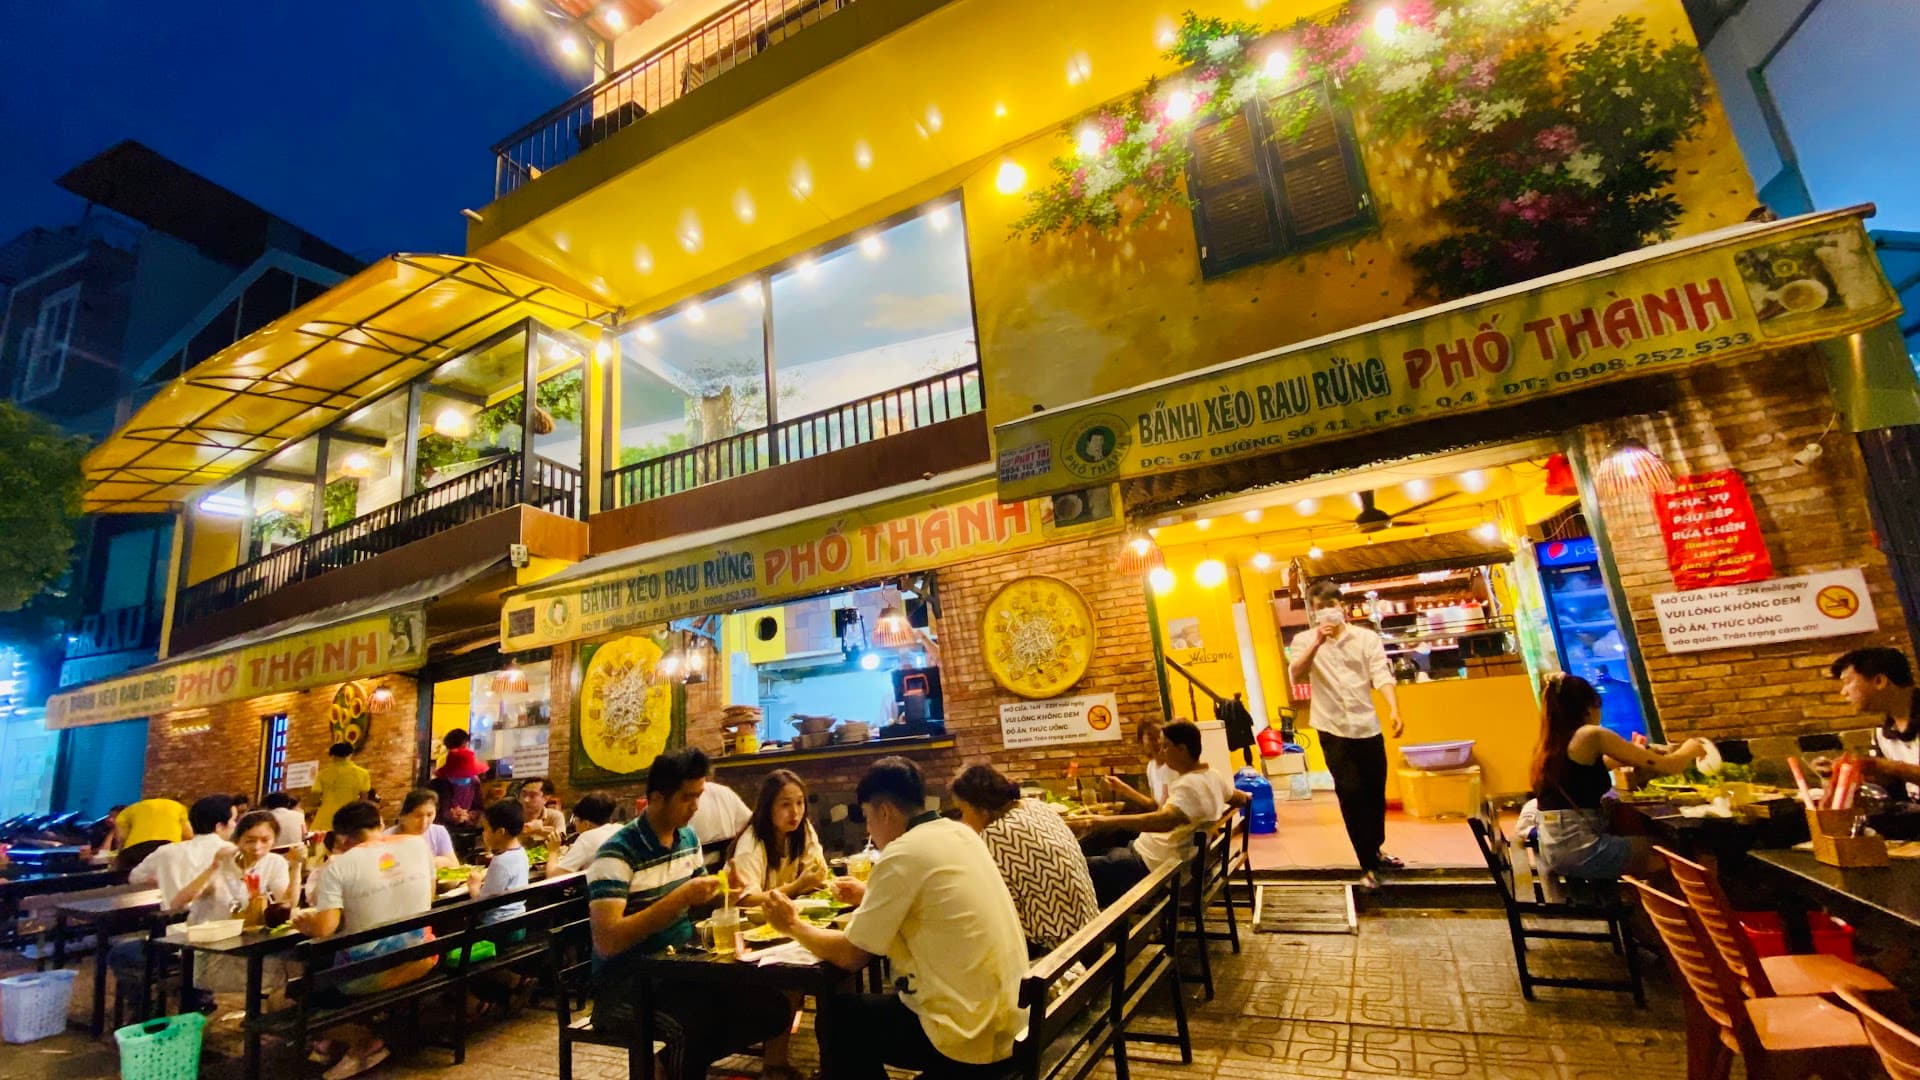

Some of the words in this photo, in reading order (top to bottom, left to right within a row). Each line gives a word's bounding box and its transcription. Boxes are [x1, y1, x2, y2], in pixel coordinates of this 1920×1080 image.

[1403, 314, 1512, 390] PHỐ
[1524, 278, 1734, 361] THÀNH
[1138, 401, 1201, 447] BÁNH
[1204, 385, 1254, 436] XÈO
[1257, 375, 1309, 423] RAU
[1312, 357, 1391, 409] RỪNG
[1179, 451, 1202, 463] 97
[1210, 433, 1283, 457] ĐƯỜNG
[1324, 419, 1350, 432] 41
[1375, 405, 1414, 422] P.6
[1555, 331, 1755, 384] 0908.252.533
[764, 519, 850, 587] PHỐ
[860, 498, 1030, 564] THÀNH
[580, 579, 623, 616] BÁNH
[625, 570, 661, 608] XÈO
[664, 564, 699, 598] RAU
[703, 549, 755, 589] RỪNG
[1665, 608, 1687, 619] VUI
[1688, 604, 1721, 617] LÒNG
[1724, 599, 1770, 614] KHÔNG
[1708, 590, 1729, 600] 14H
[1737, 586, 1760, 597] 22H
[1748, 613, 1783, 626] UỐNG
[1190, 648, 1234, 663] Welcome
